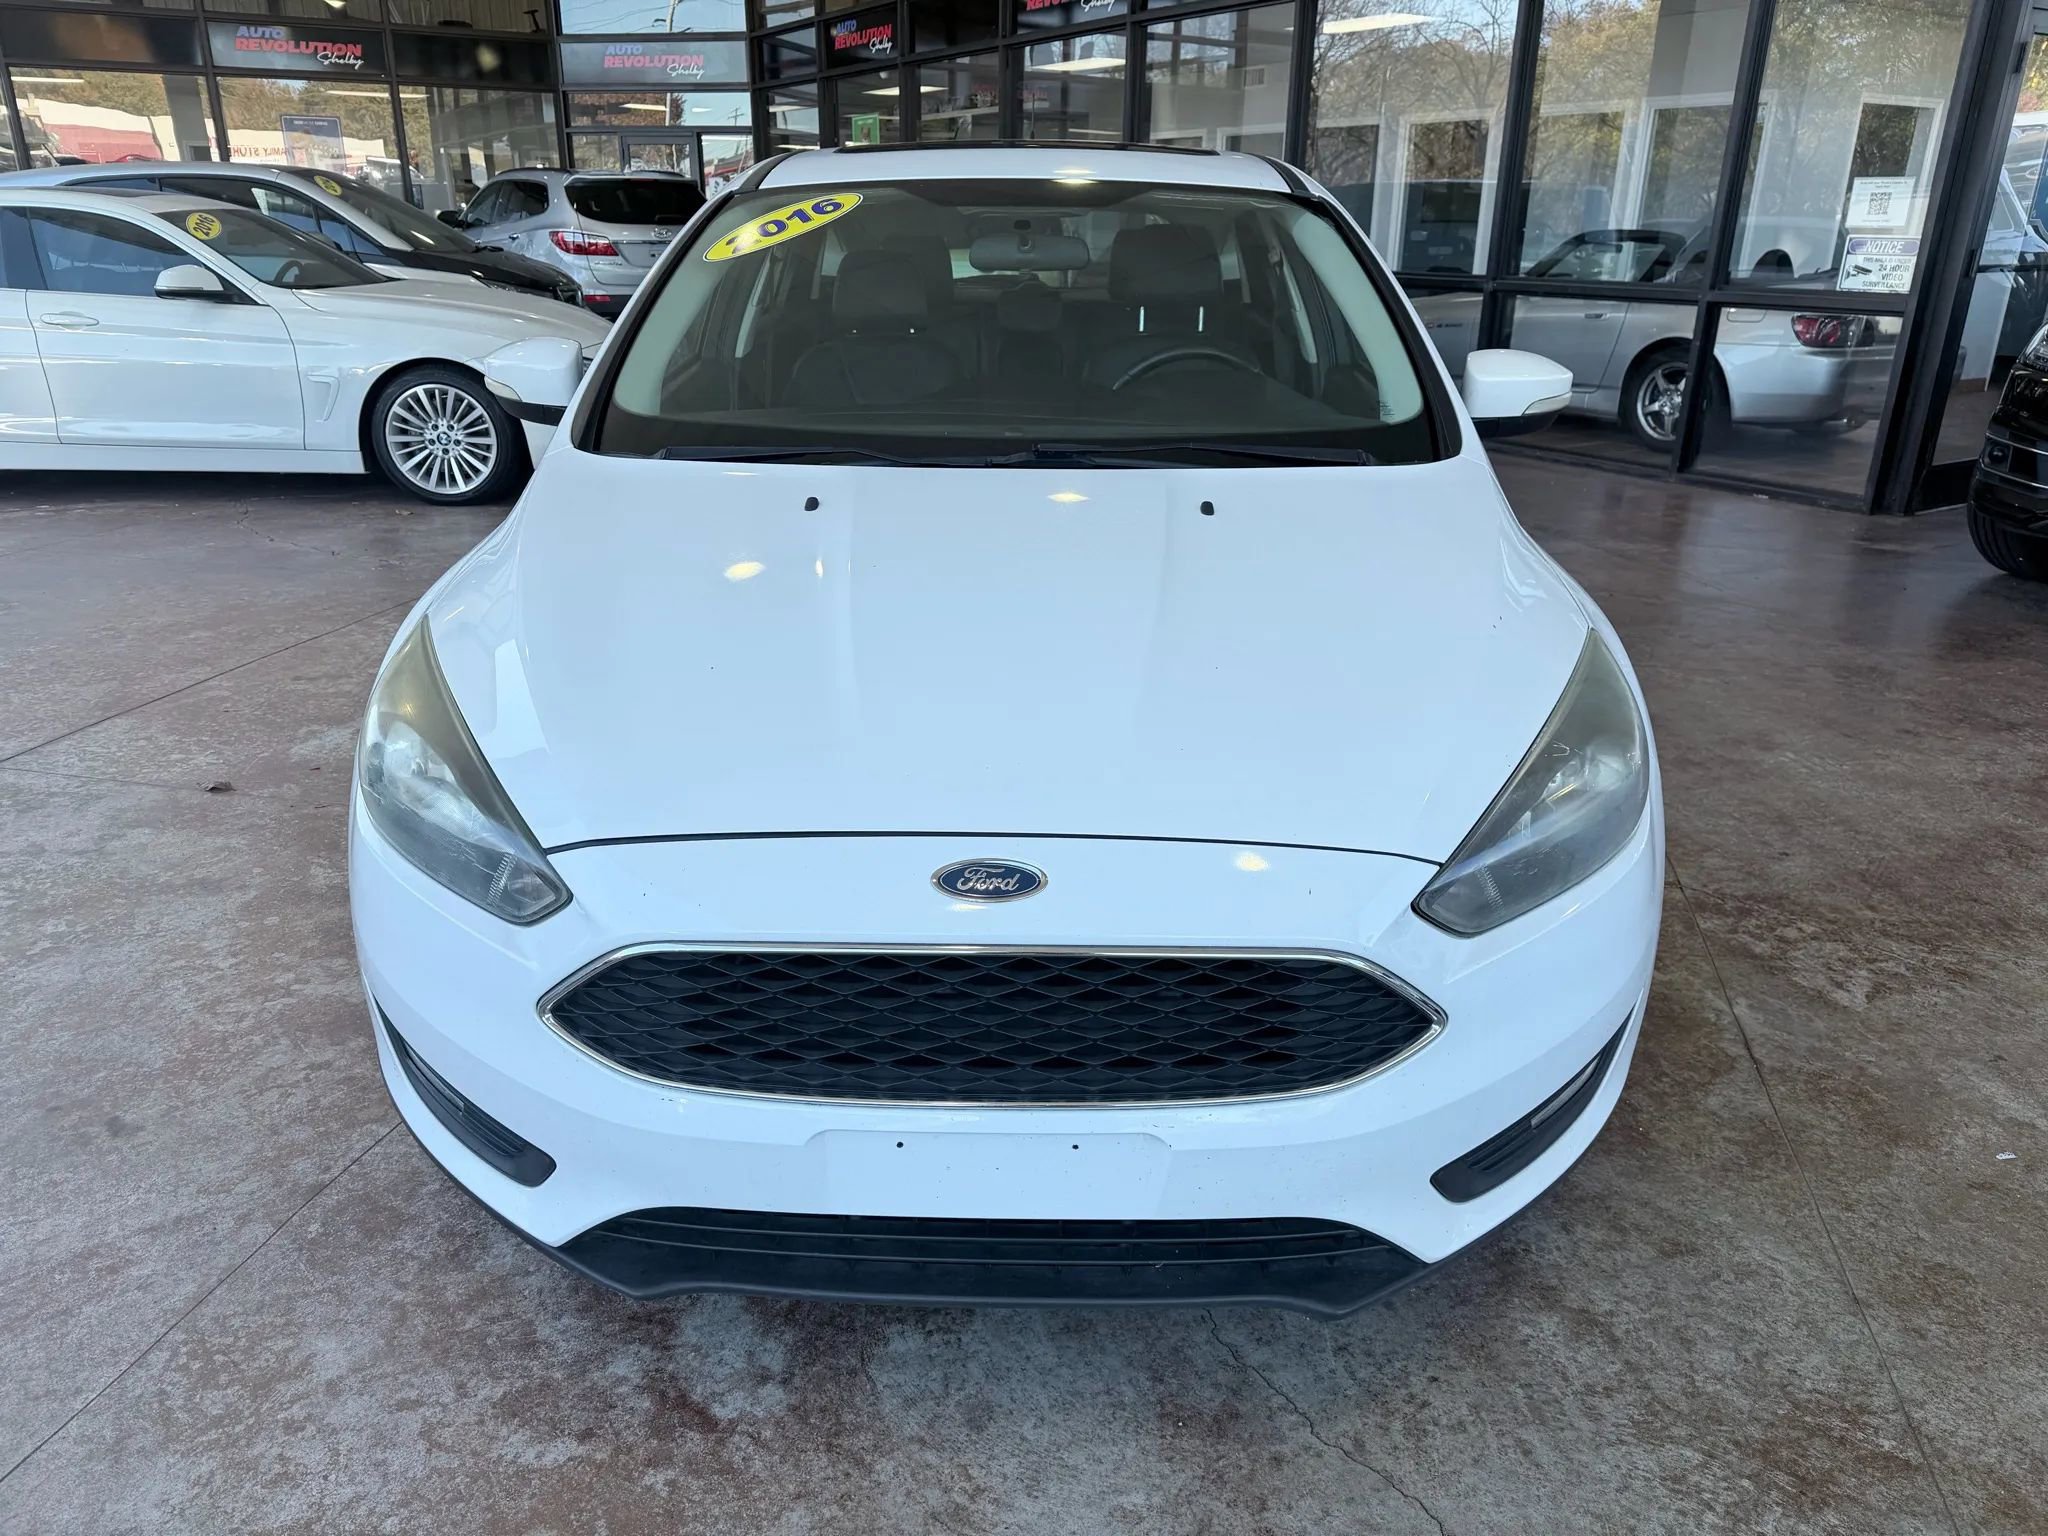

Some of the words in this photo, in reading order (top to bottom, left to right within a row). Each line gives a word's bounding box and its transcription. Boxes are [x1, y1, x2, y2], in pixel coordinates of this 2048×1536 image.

[236, 25, 285, 38] AUTO
[836, 20, 857, 32] AUTO
[834, 24, 892, 50] REVOLUTION
[235, 37, 362, 57] REVOLUTION
[605, 44, 643, 55] AUTO
[316, 51, 365, 70] Shelby
[603, 54, 704, 68] REVOLUTION
[666, 63, 705, 79] Shelby
[194, 213, 217, 237] 2016
[1865, 240, 1904, 253] NOTICE
[1878, 264, 1888, 272] 24
[1889, 264, 1911, 273] HOUR
[1881, 273, 1904, 281] VIDEO
[957, 867, 1021, 891] Ford
